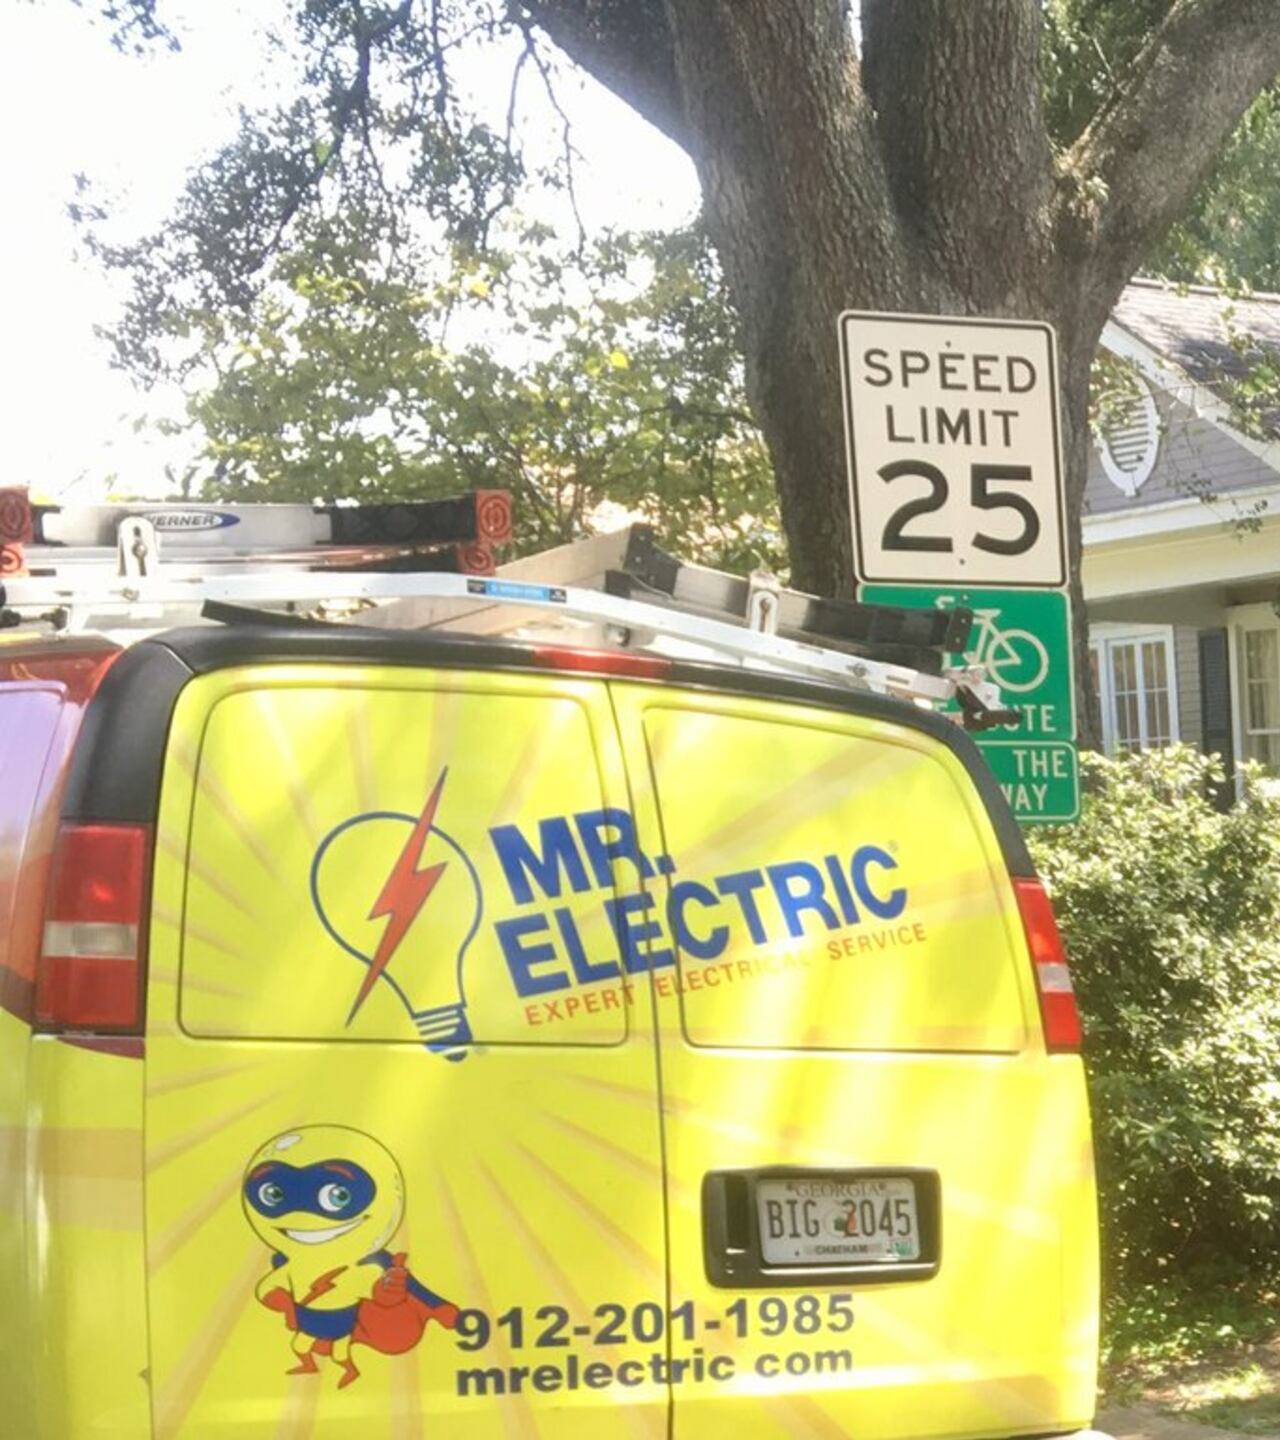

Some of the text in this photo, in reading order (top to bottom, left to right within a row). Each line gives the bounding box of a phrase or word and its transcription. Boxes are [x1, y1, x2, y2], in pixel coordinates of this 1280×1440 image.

[863, 348, 1037, 393] SPEED
[885, 405, 1019, 447] LIMIT
[876, 459, 1040, 556] 25
[1013, 750, 1068, 778] THE
[488, 807, 676, 905] MR.
[494, 845, 907, 998] ELECTRIC
[525, 984, 635, 1026] EXPERT
[828, 923, 928, 961] SERVICE
[795, 1181, 880, 1198] GEORGIA
[766, 1199, 911, 1239] BIG 2045
[456, 1293, 855, 1352] 912-201-1985
